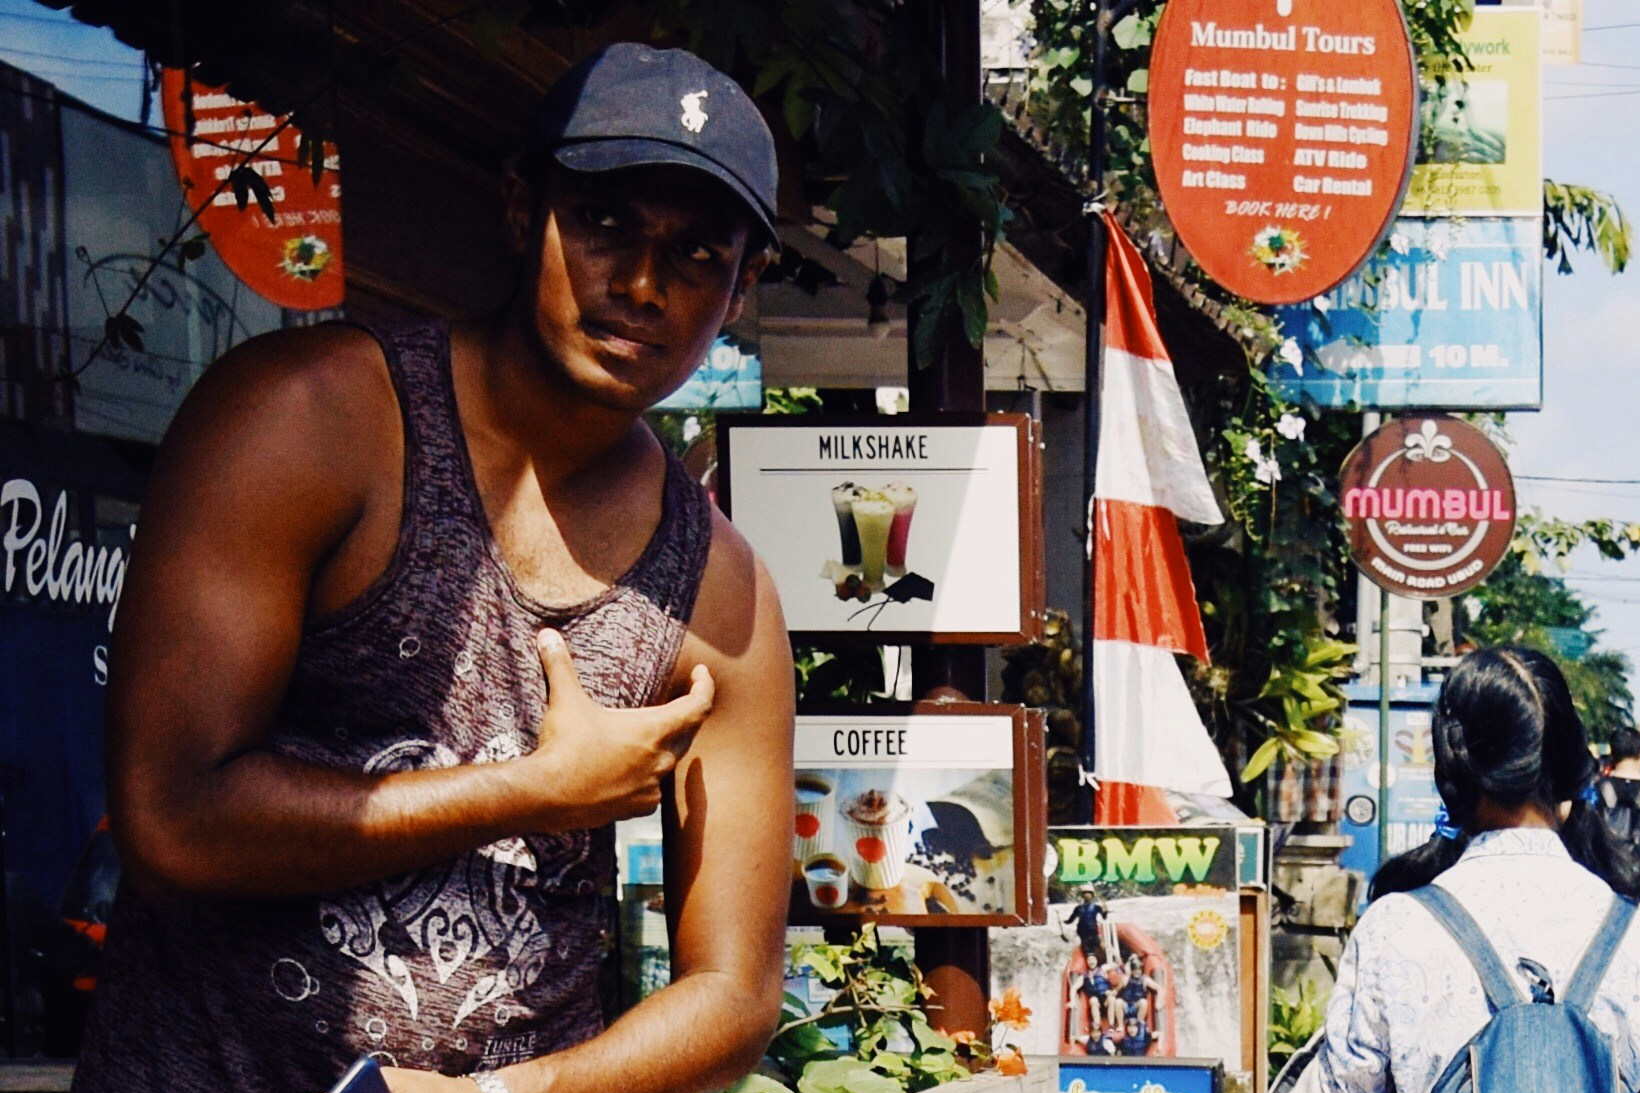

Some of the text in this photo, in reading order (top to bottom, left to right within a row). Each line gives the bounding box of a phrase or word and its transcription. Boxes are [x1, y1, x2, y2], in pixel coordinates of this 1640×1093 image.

[1190, 21, 1376, 55] Mumbul Tours
[1461, 38, 1511, 55] ywork
[1184, 68, 1218, 87] Fast
[1219, 70, 1257, 89] Boat
[1215, 95, 1247, 113] Water
[1295, 98, 1388, 122] Sunrise Trekking
[1183, 116, 1278, 138] Elephant Ride
[1294, 123, 1324, 141] Down
[1348, 125, 1389, 147] Cycling
[1182, 143, 1265, 164] Cooking Class
[1293, 147, 1368, 169] ATV Ride
[1182, 170, 1246, 190] Art Class
[1293, 175, 1373, 196] Car Rental
[1225, 200, 1271, 216] BOOK
[1275, 202, 1321, 222] HERE
[1460, 261, 1529, 311] INN
[1429, 345, 1468, 368] 10
[818, 434, 930, 462] MILKSHAKE
[1345, 487, 1510, 520] MUMBUL
[1, 478, 137, 633] Pelang
[1403, 544, 1428, 553] FREE
[1370, 556, 1484, 589] MAIN ROAD UBUD
[832, 729, 908, 757] COFFEE
[1059, 836, 1221, 883] BMW
